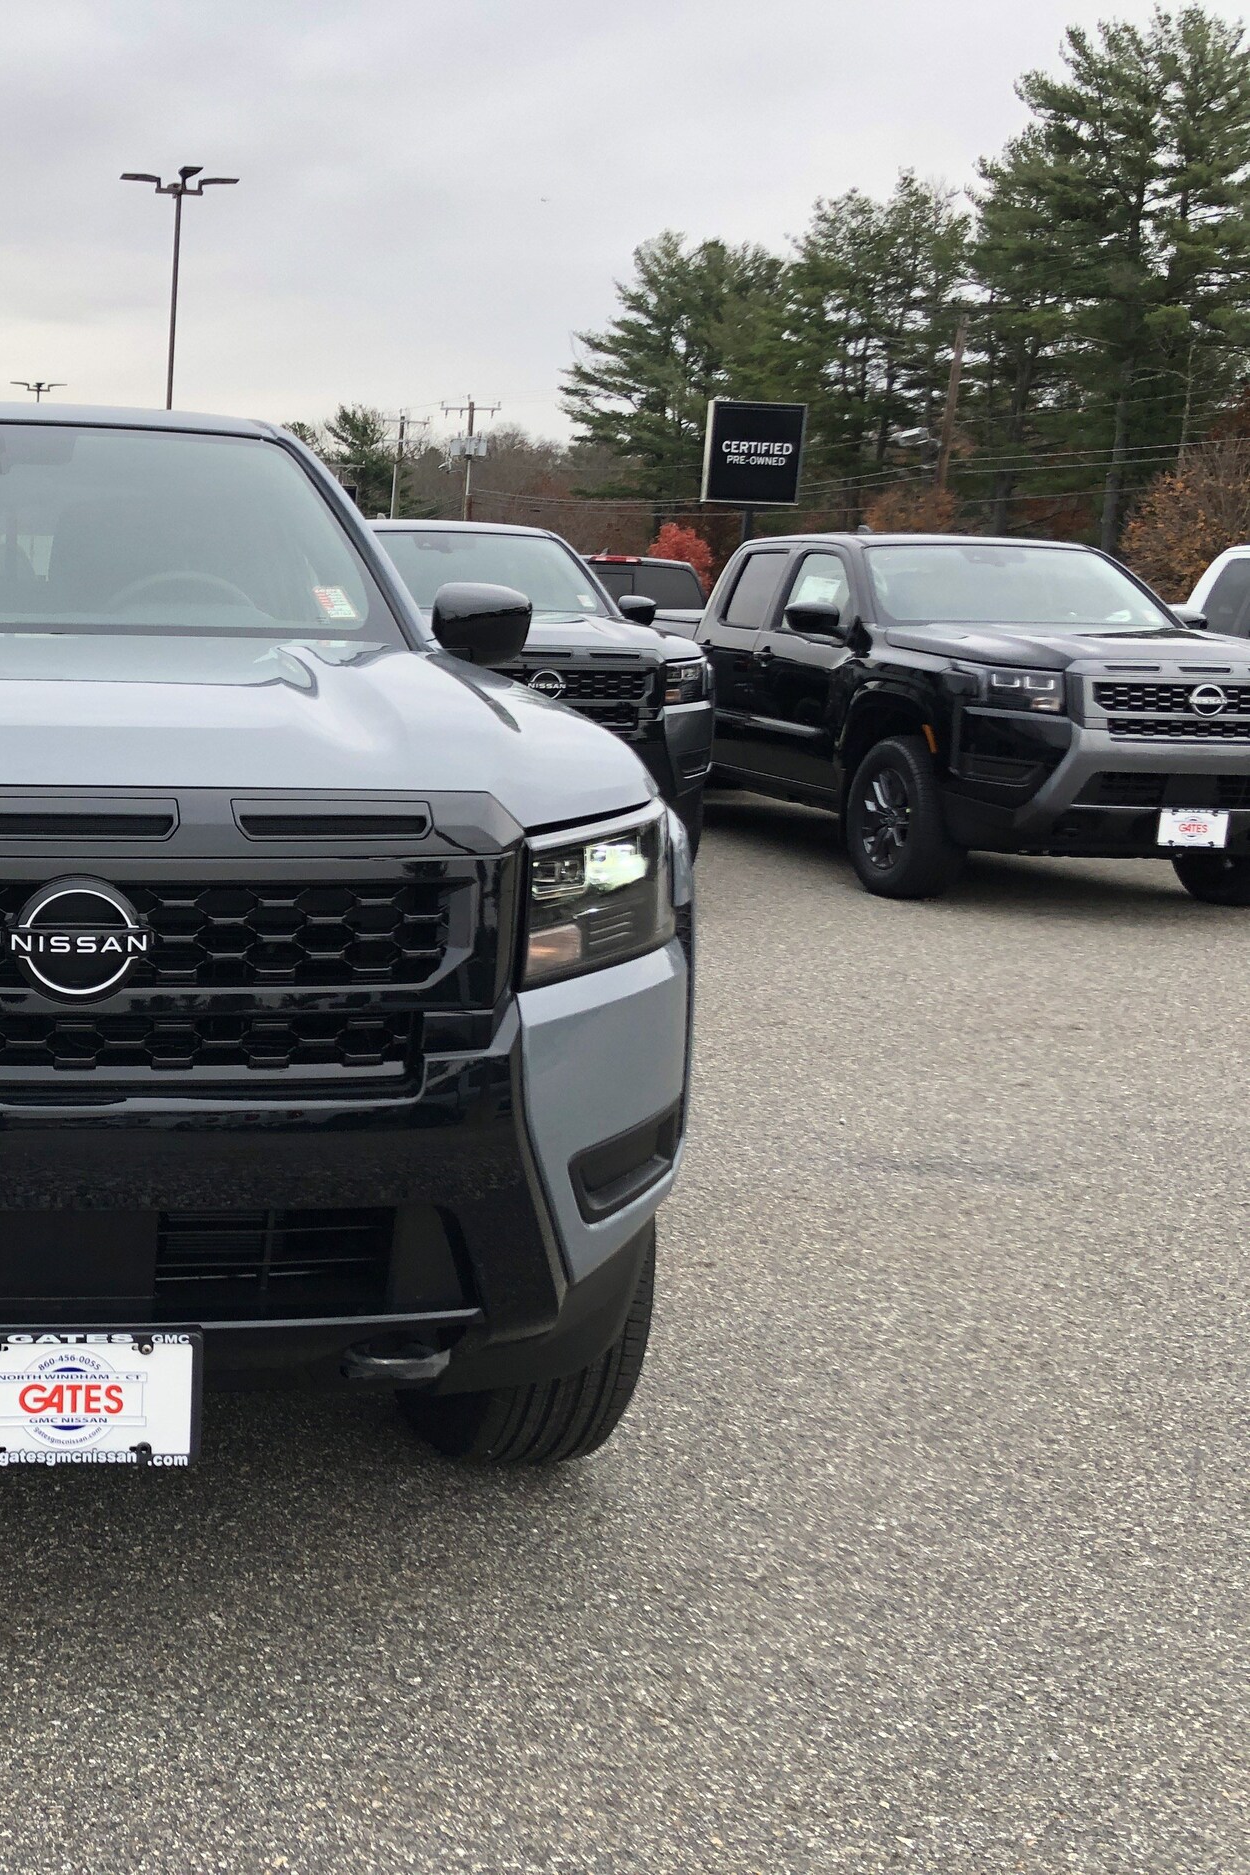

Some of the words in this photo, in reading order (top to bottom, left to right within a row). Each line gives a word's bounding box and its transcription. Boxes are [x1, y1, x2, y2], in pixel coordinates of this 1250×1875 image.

[722, 440, 792, 455] CERTIFIED
[726, 455, 786, 466] PRE-OWNED
[1179, 824, 1208, 833] GATES
[11, 934, 148, 953] NISSAN
[7, 1334, 133, 1344] GATES
[151, 1335, 189, 1344] GMC
[38, 1355, 101, 1371] 860-456-0055
[19, 1384, 123, 1414] GATES
[33, 1427, 102, 1445] gatesgmcnissan.com
